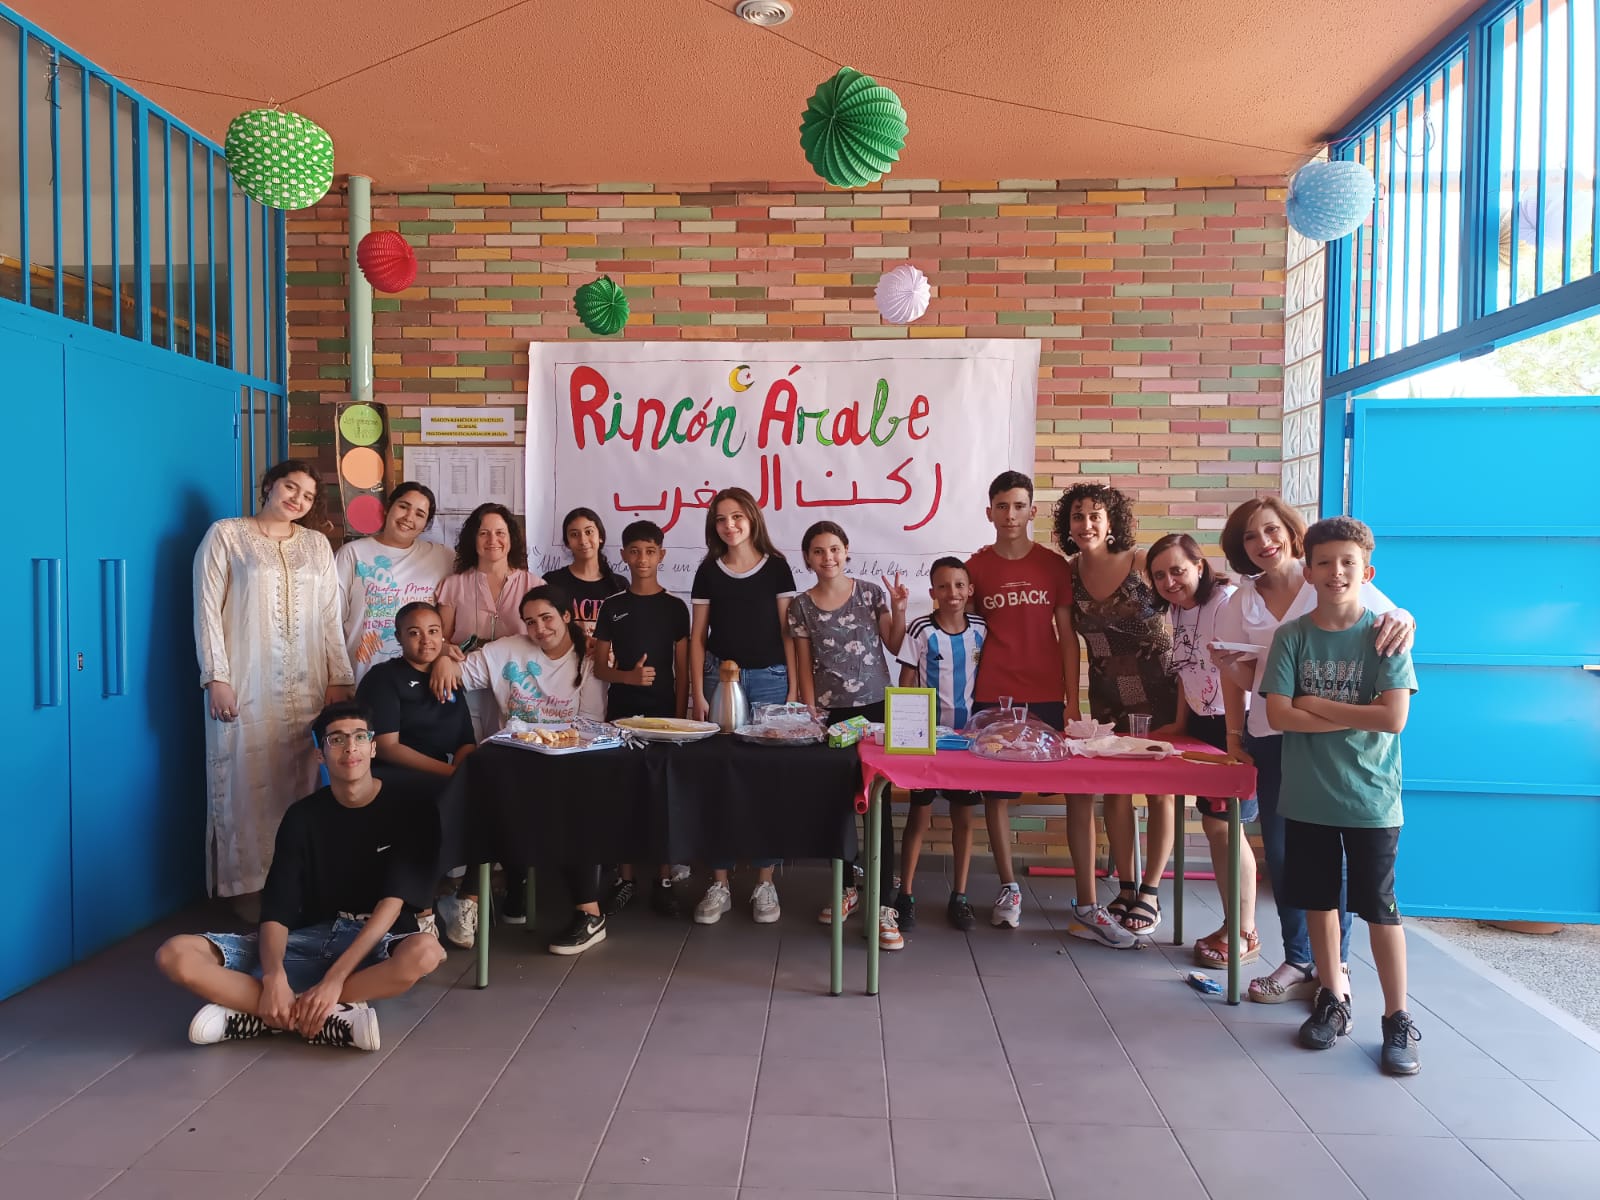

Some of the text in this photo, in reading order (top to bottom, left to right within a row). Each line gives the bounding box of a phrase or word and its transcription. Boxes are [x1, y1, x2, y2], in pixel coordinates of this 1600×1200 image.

[570, 365, 929, 458] Rincón Árabe
[614, 454, 782, 533] الغرب
[983, 589, 1050, 610] GO BACK.
